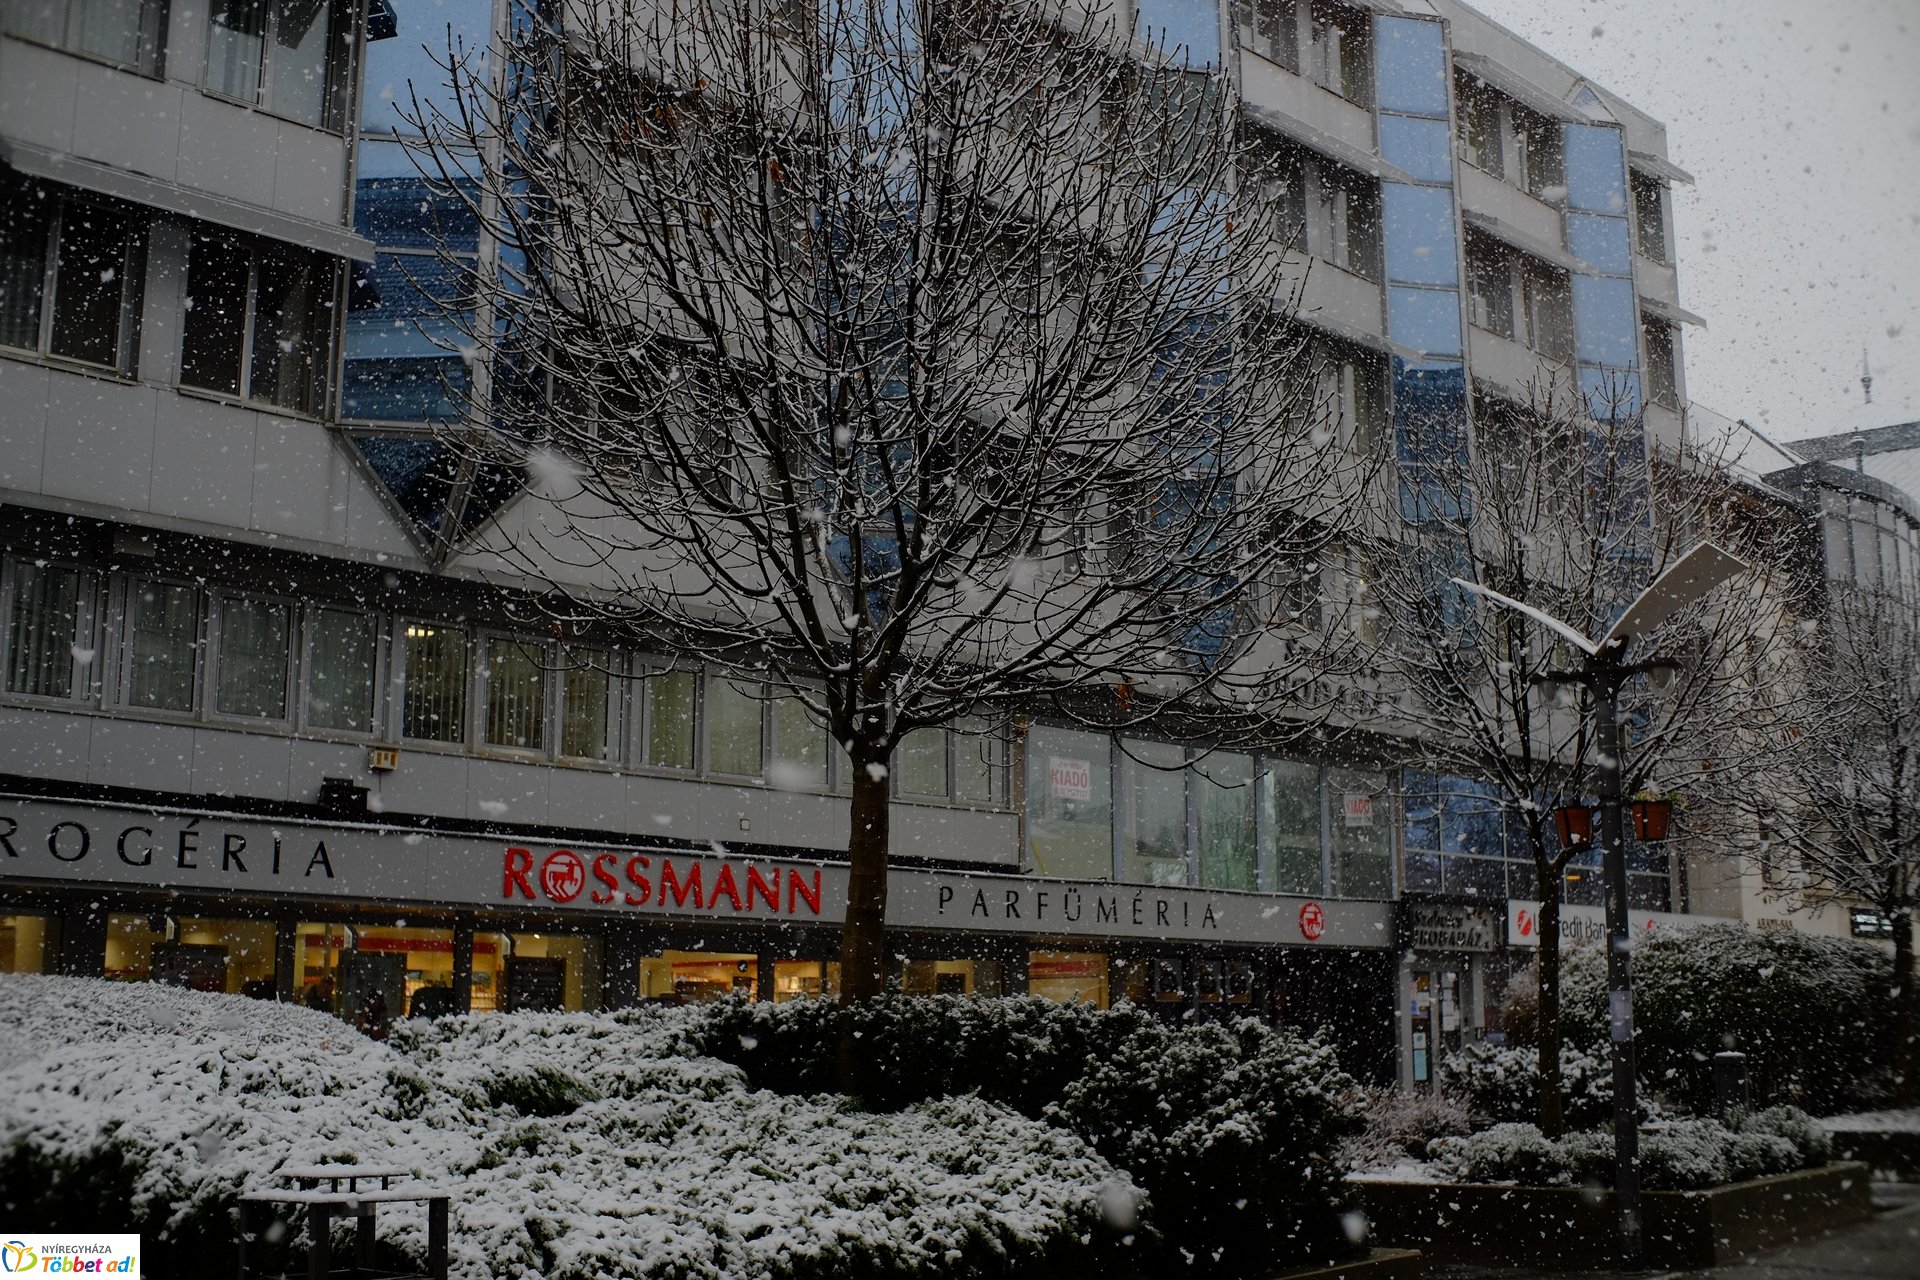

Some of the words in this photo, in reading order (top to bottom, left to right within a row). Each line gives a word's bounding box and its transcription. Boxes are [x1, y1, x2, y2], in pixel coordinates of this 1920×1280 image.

[1050, 767, 1088, 789] KIADÓ
[502, 847, 822, 916] ROSSMANN
[938, 885, 1219, 930] PARFÜMÉRIA
